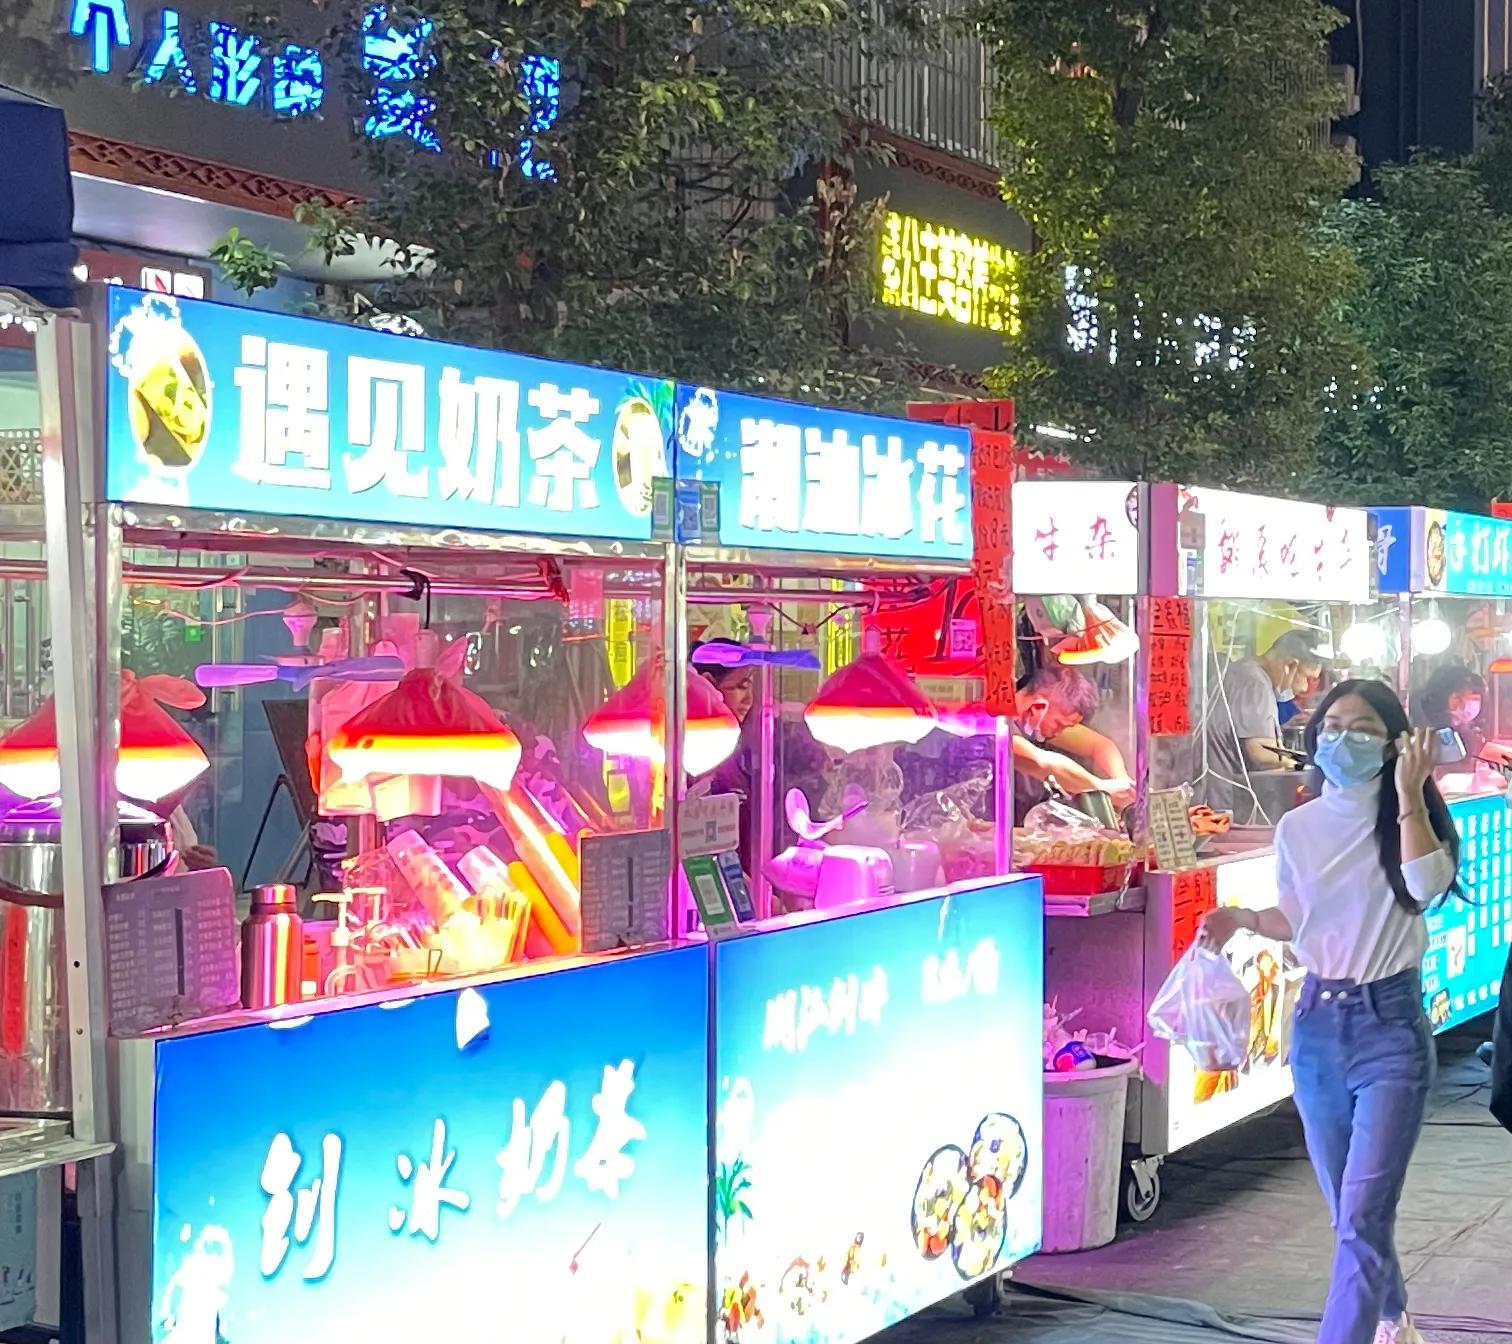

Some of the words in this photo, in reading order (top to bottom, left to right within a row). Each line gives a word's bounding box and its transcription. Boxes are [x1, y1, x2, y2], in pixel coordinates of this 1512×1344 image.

[233, 335, 601, 512] 遇见奶茶
[1034, 515, 1117, 561] 牛杂
